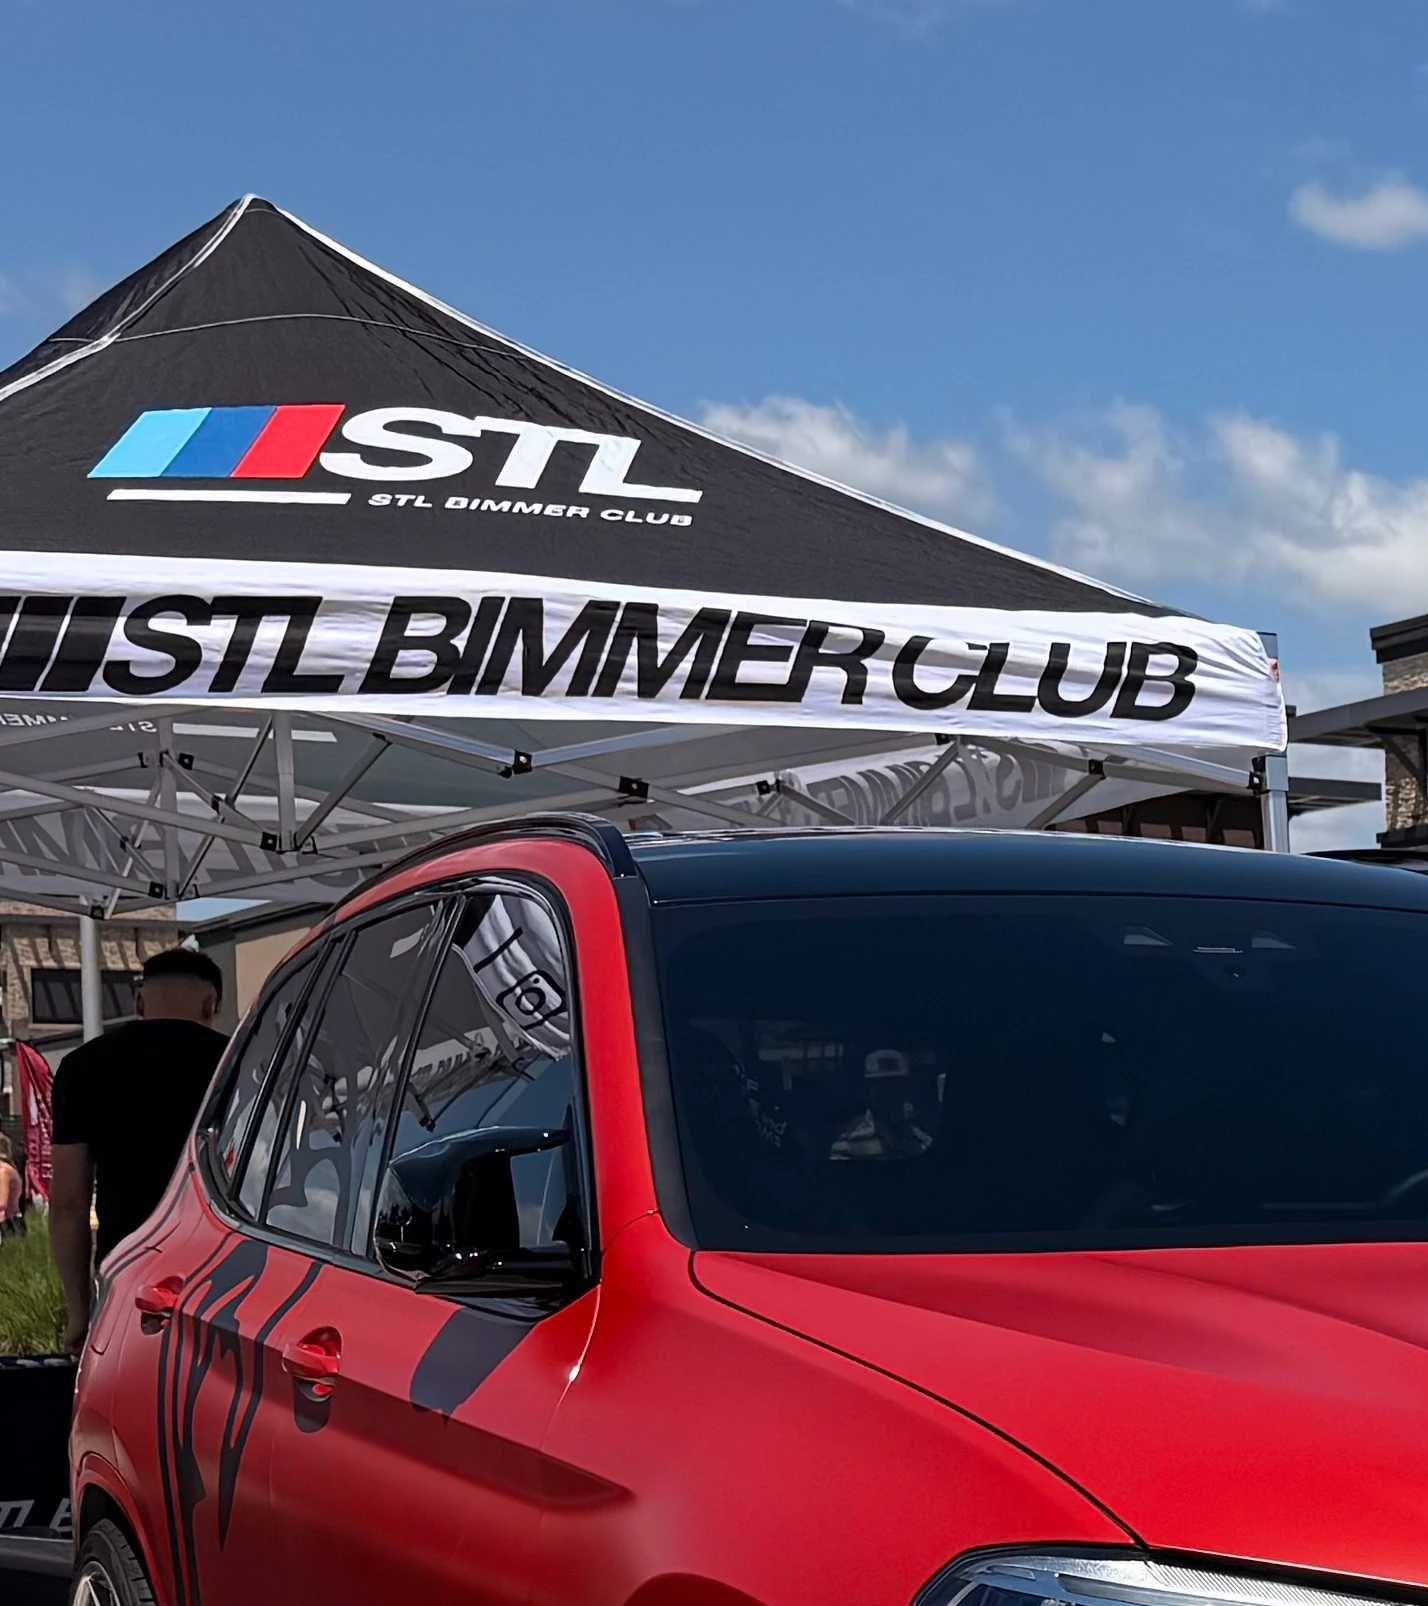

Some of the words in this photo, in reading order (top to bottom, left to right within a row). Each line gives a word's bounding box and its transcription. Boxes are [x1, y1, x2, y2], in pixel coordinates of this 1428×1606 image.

[320, 407, 703, 502] STL
[368, 493, 432, 508] STL
[444, 496, 590, 518] BIMMER
[600, 509, 693, 527] CLUB
[102, 595, 345, 696] STL
[358, 595, 885, 705] BIMMER
[892, 635, 1199, 721] CLUB
